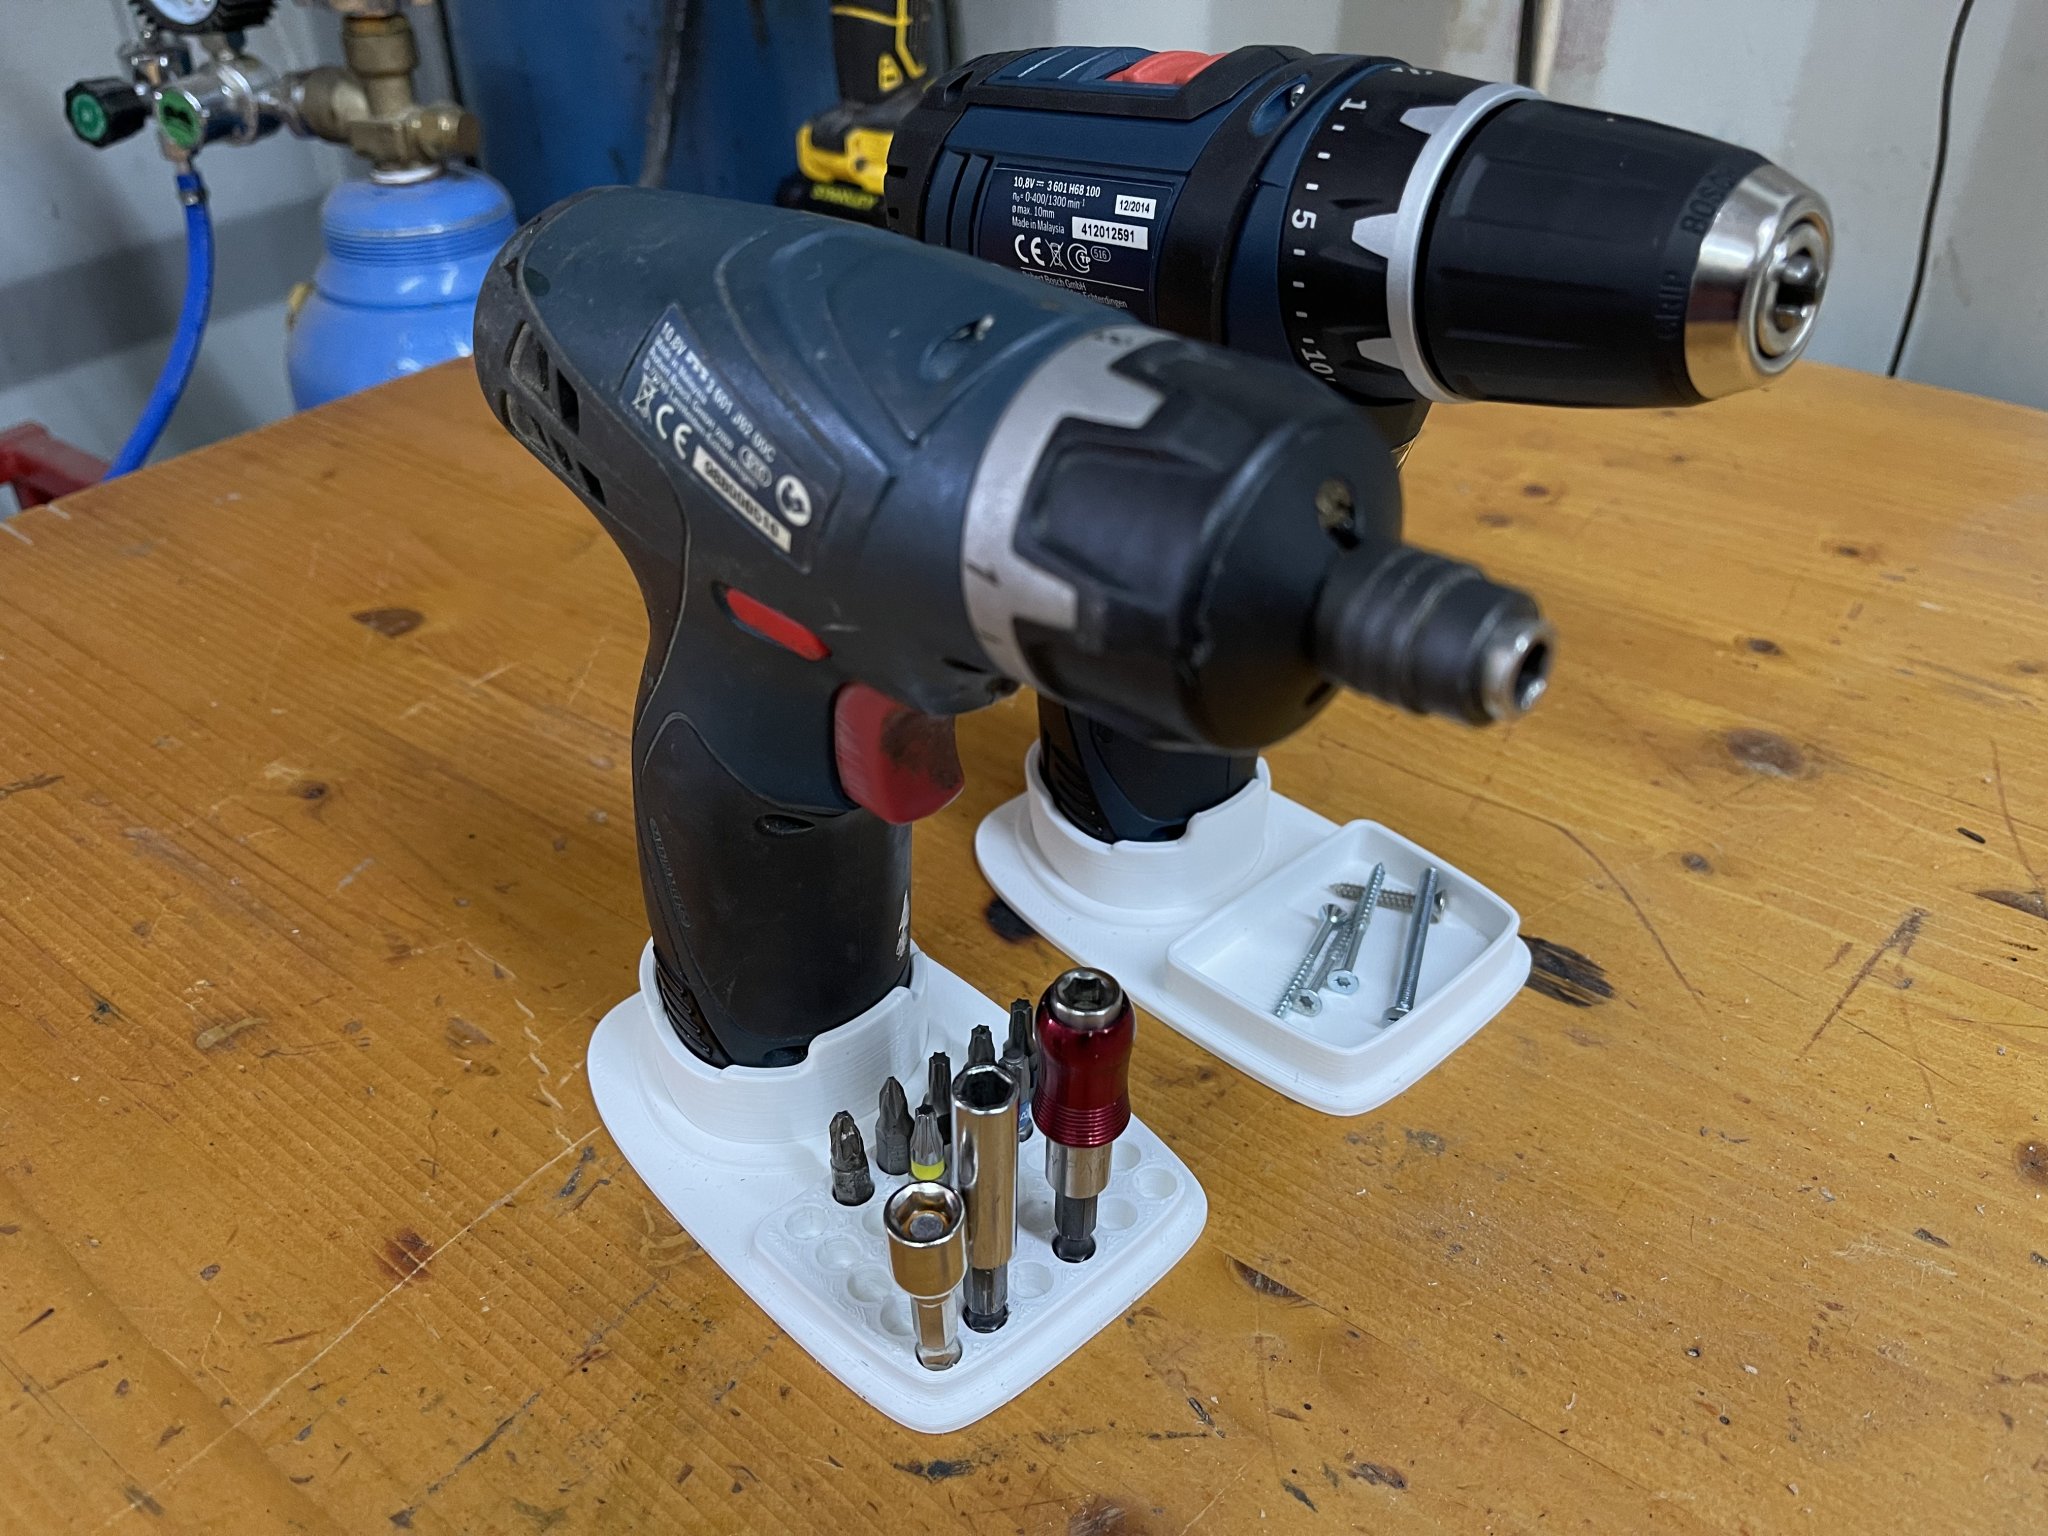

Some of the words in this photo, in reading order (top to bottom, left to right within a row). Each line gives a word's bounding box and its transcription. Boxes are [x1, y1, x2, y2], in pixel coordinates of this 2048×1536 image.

[1013, 176, 1036, 190] 10,8V
[1046, 180, 1053, 192] 3
[1053, 181, 1068, 194] 601
[1068, 183, 1085, 196] H68
[1085, 185, 1101, 198] 100
[1034, 205, 1055, 219] 10mm
[1119, 199, 1150, 214] 12/2014
[1011, 216, 1030, 229] Made
[1030, 218, 1037, 230] in
[1037, 219, 1065, 235] Malaysia
[1291, 208, 1317, 230] 5
[1081, 222, 1136, 243] 412012591
[1301, 347, 1334, 376] 10
